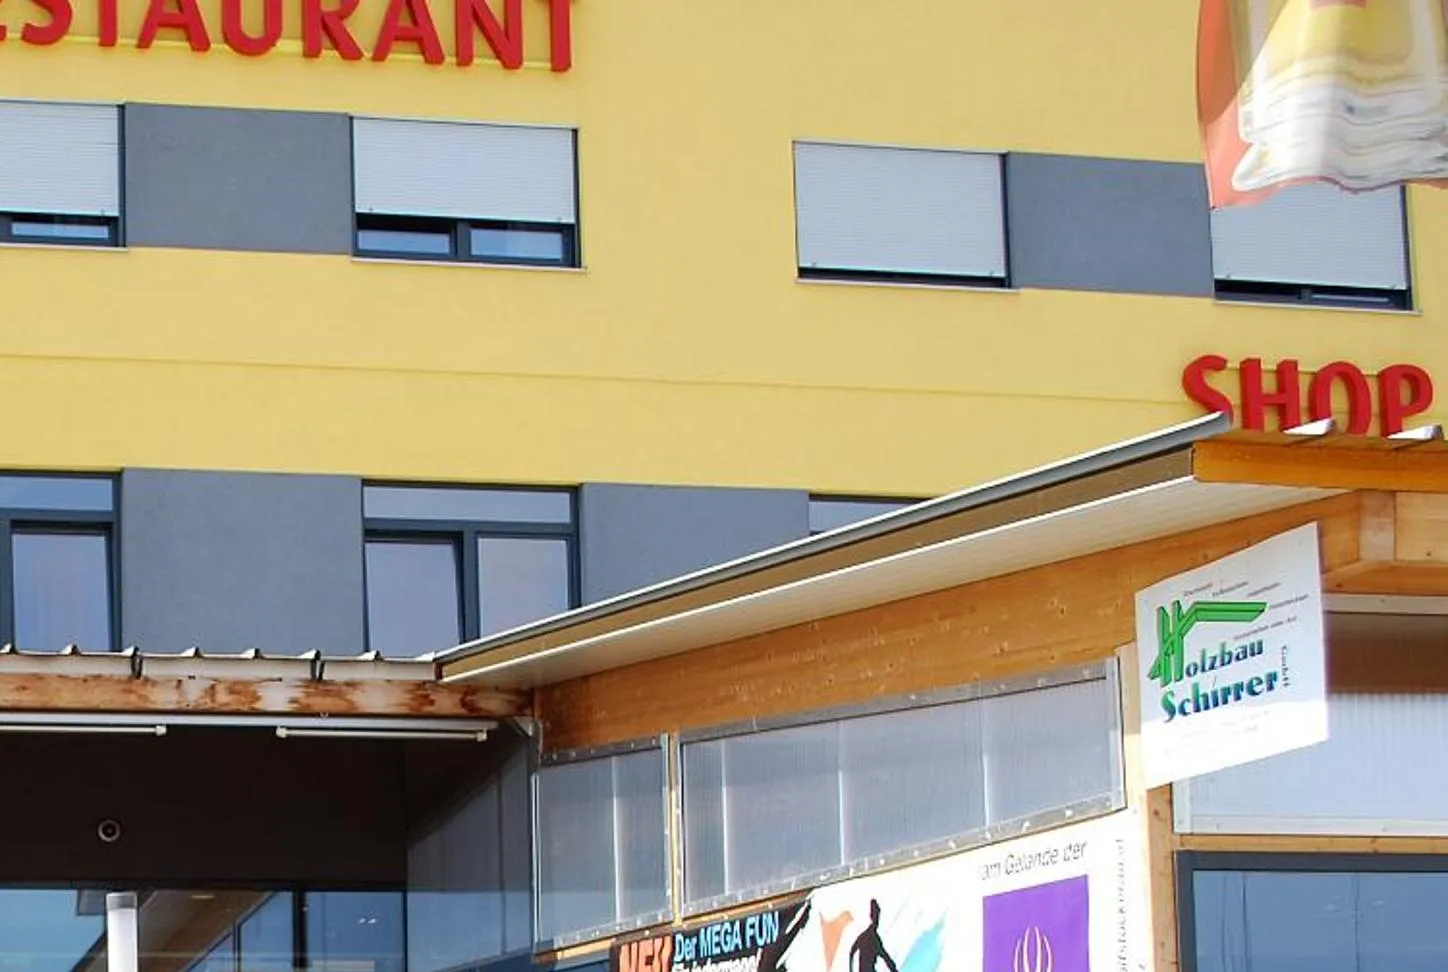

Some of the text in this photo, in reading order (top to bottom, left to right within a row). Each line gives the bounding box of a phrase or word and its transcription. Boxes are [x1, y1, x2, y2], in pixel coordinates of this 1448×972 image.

[1182, 354, 1434, 438] SHOP
[1147, 600, 1266, 688] Holzbau
[1161, 671, 1278, 723] Schirrer
[674, 910, 780, 962] Der MEGA FUN
